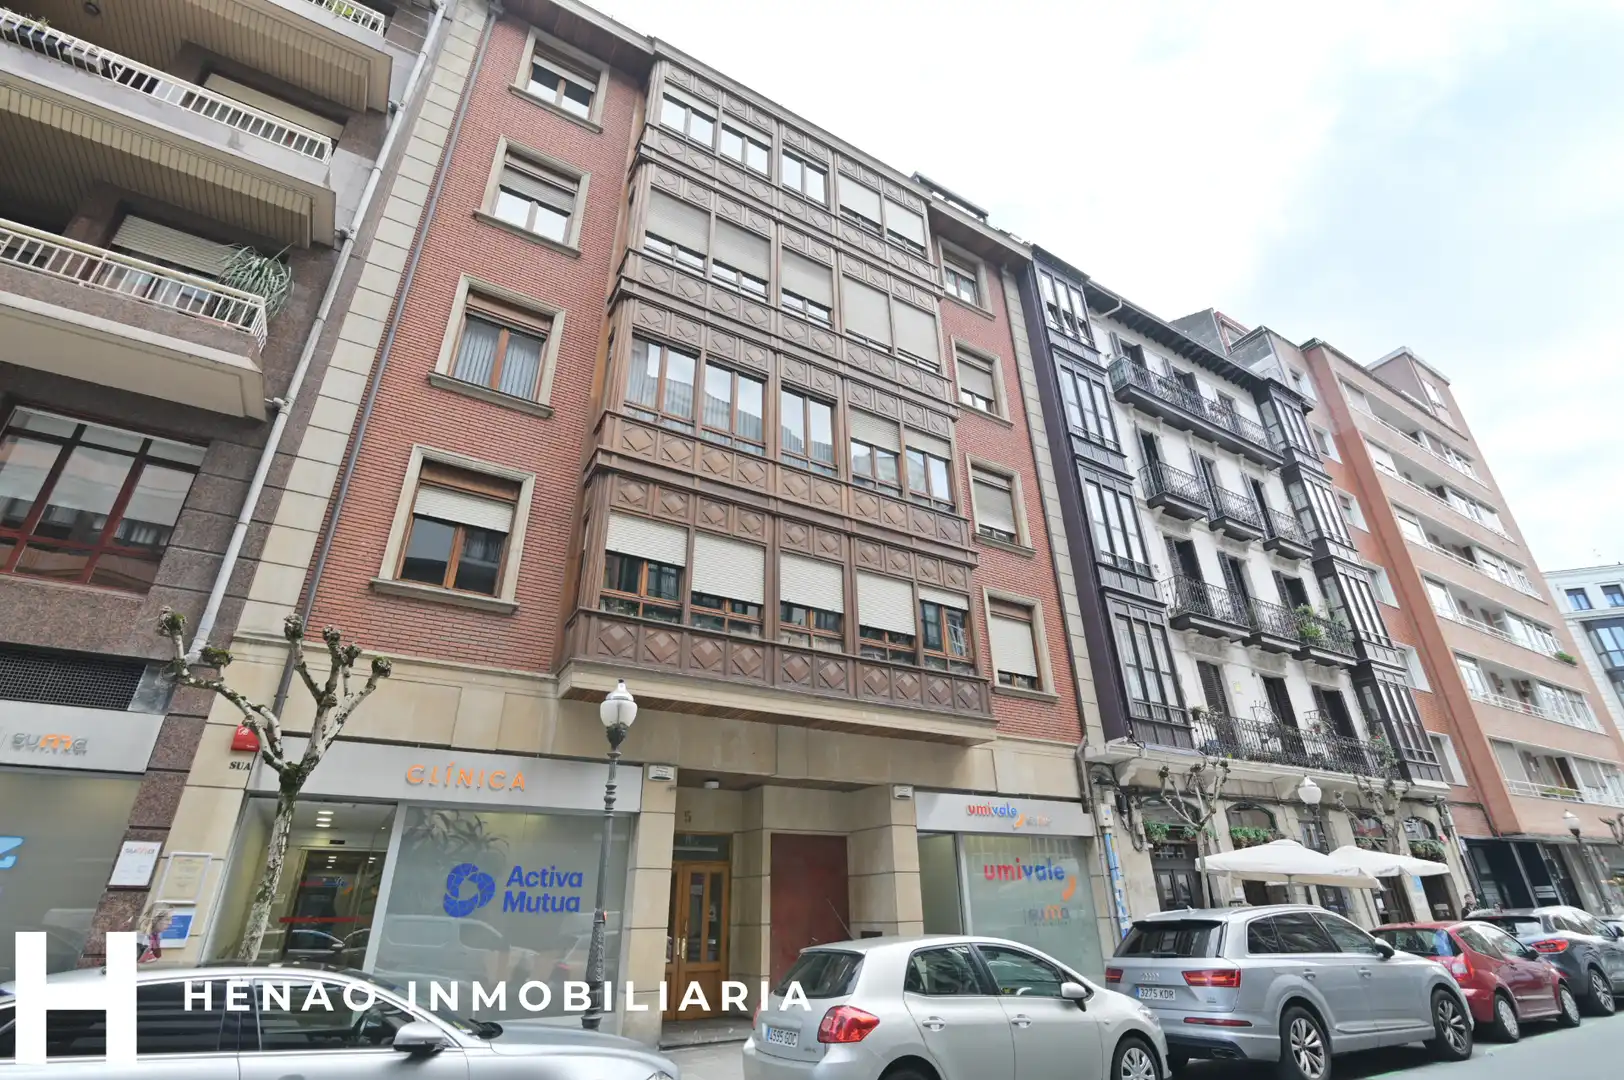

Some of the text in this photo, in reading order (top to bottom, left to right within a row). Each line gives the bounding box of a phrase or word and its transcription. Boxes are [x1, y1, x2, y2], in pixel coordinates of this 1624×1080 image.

[229, 761, 251, 771] SUA
[406, 762, 526, 791] CLÍNICA
[966, 801, 1017, 818] umivale
[506, 865, 583, 888] Activa
[984, 857, 1065, 881] umivale
[503, 891, 580, 914] Mutua
[1140, 988, 1159, 998] 3275
